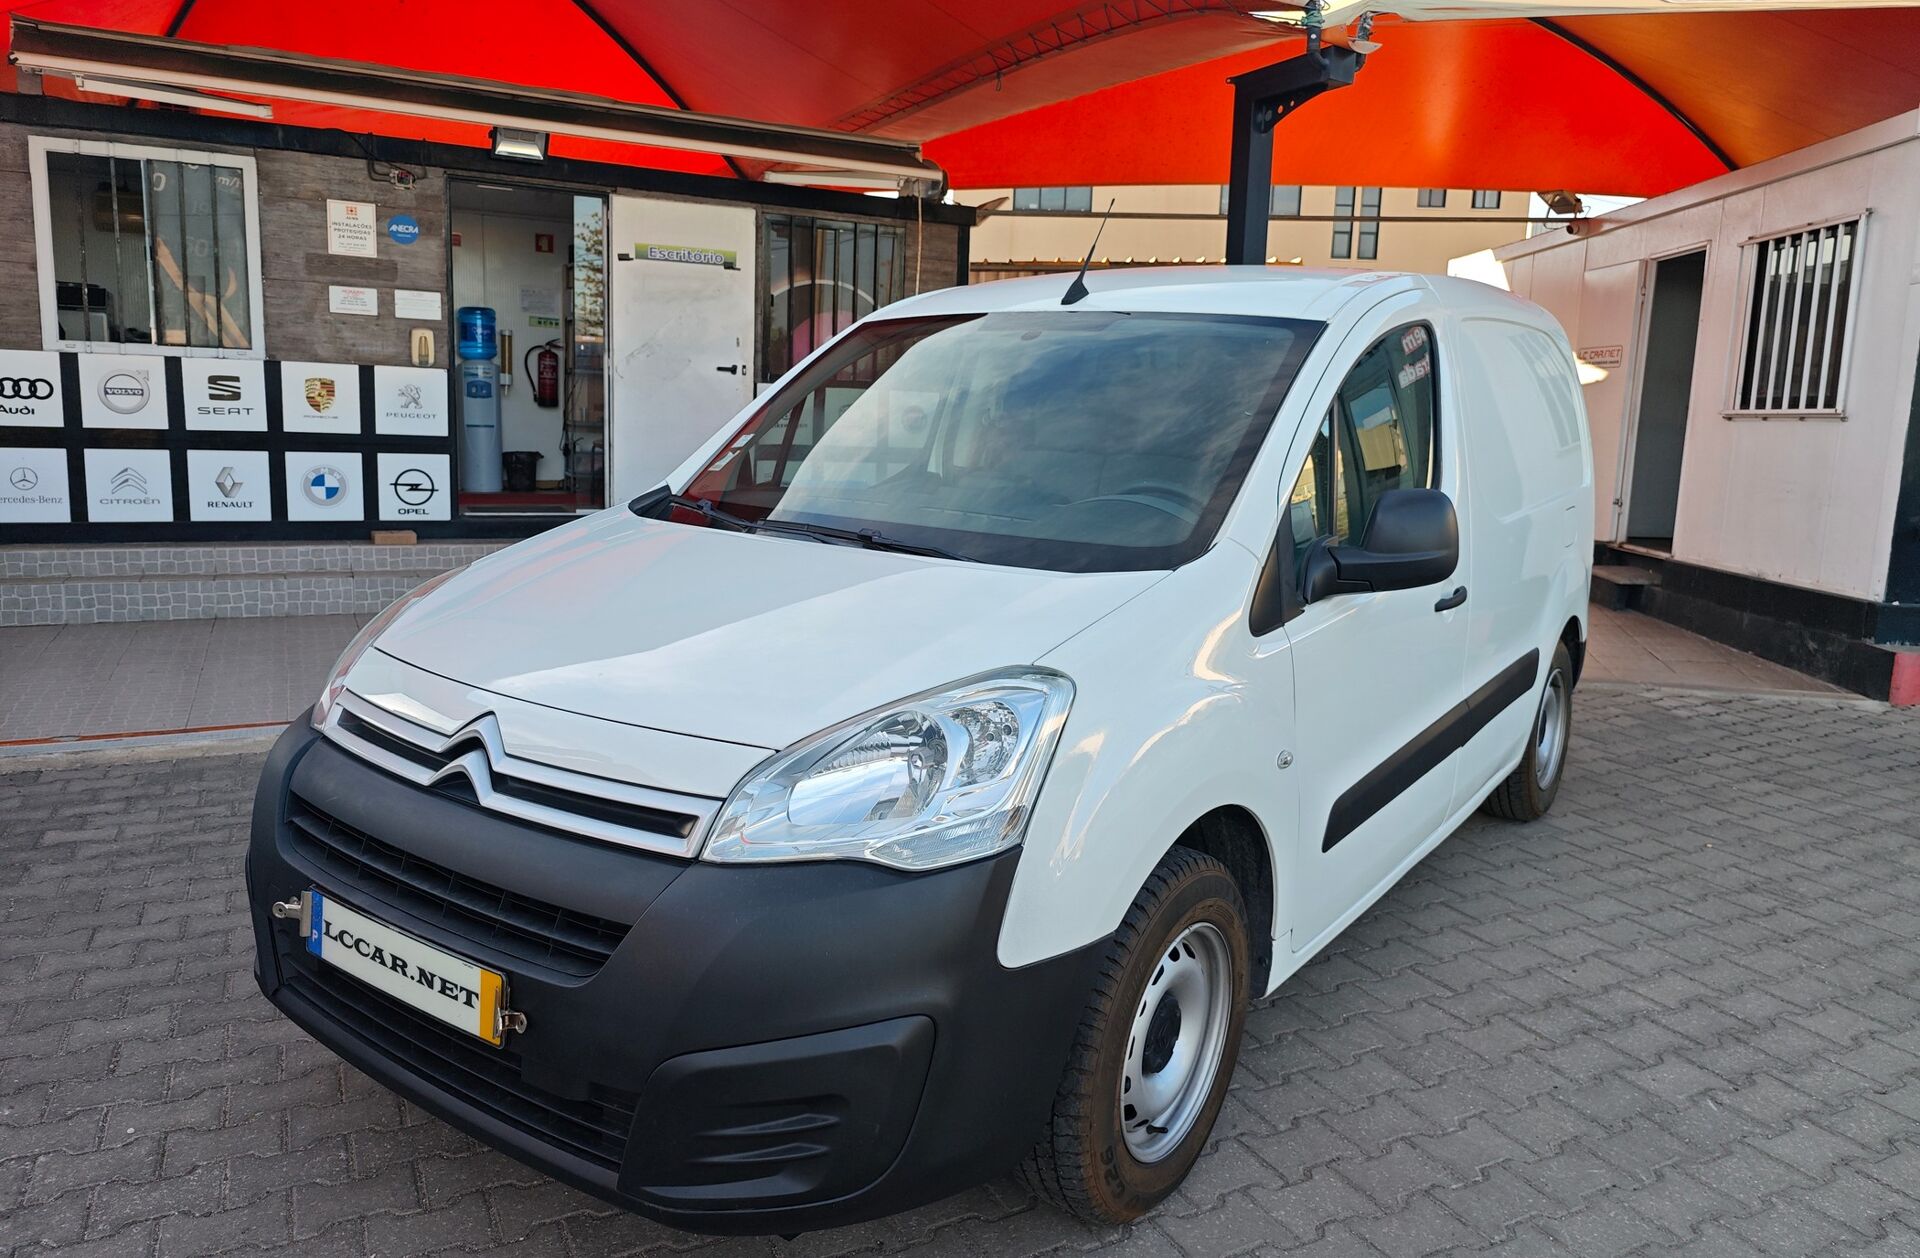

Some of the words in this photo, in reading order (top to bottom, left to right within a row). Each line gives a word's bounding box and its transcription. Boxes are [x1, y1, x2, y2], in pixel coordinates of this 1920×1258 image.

[648, 246, 724, 264] Escritório
[0, 405, 35, 415] Audi
[197, 406, 254, 415] SEAT
[0, 495, 63, 504] ercedes-Benz
[323, 919, 480, 1009] LCCAR.NET
